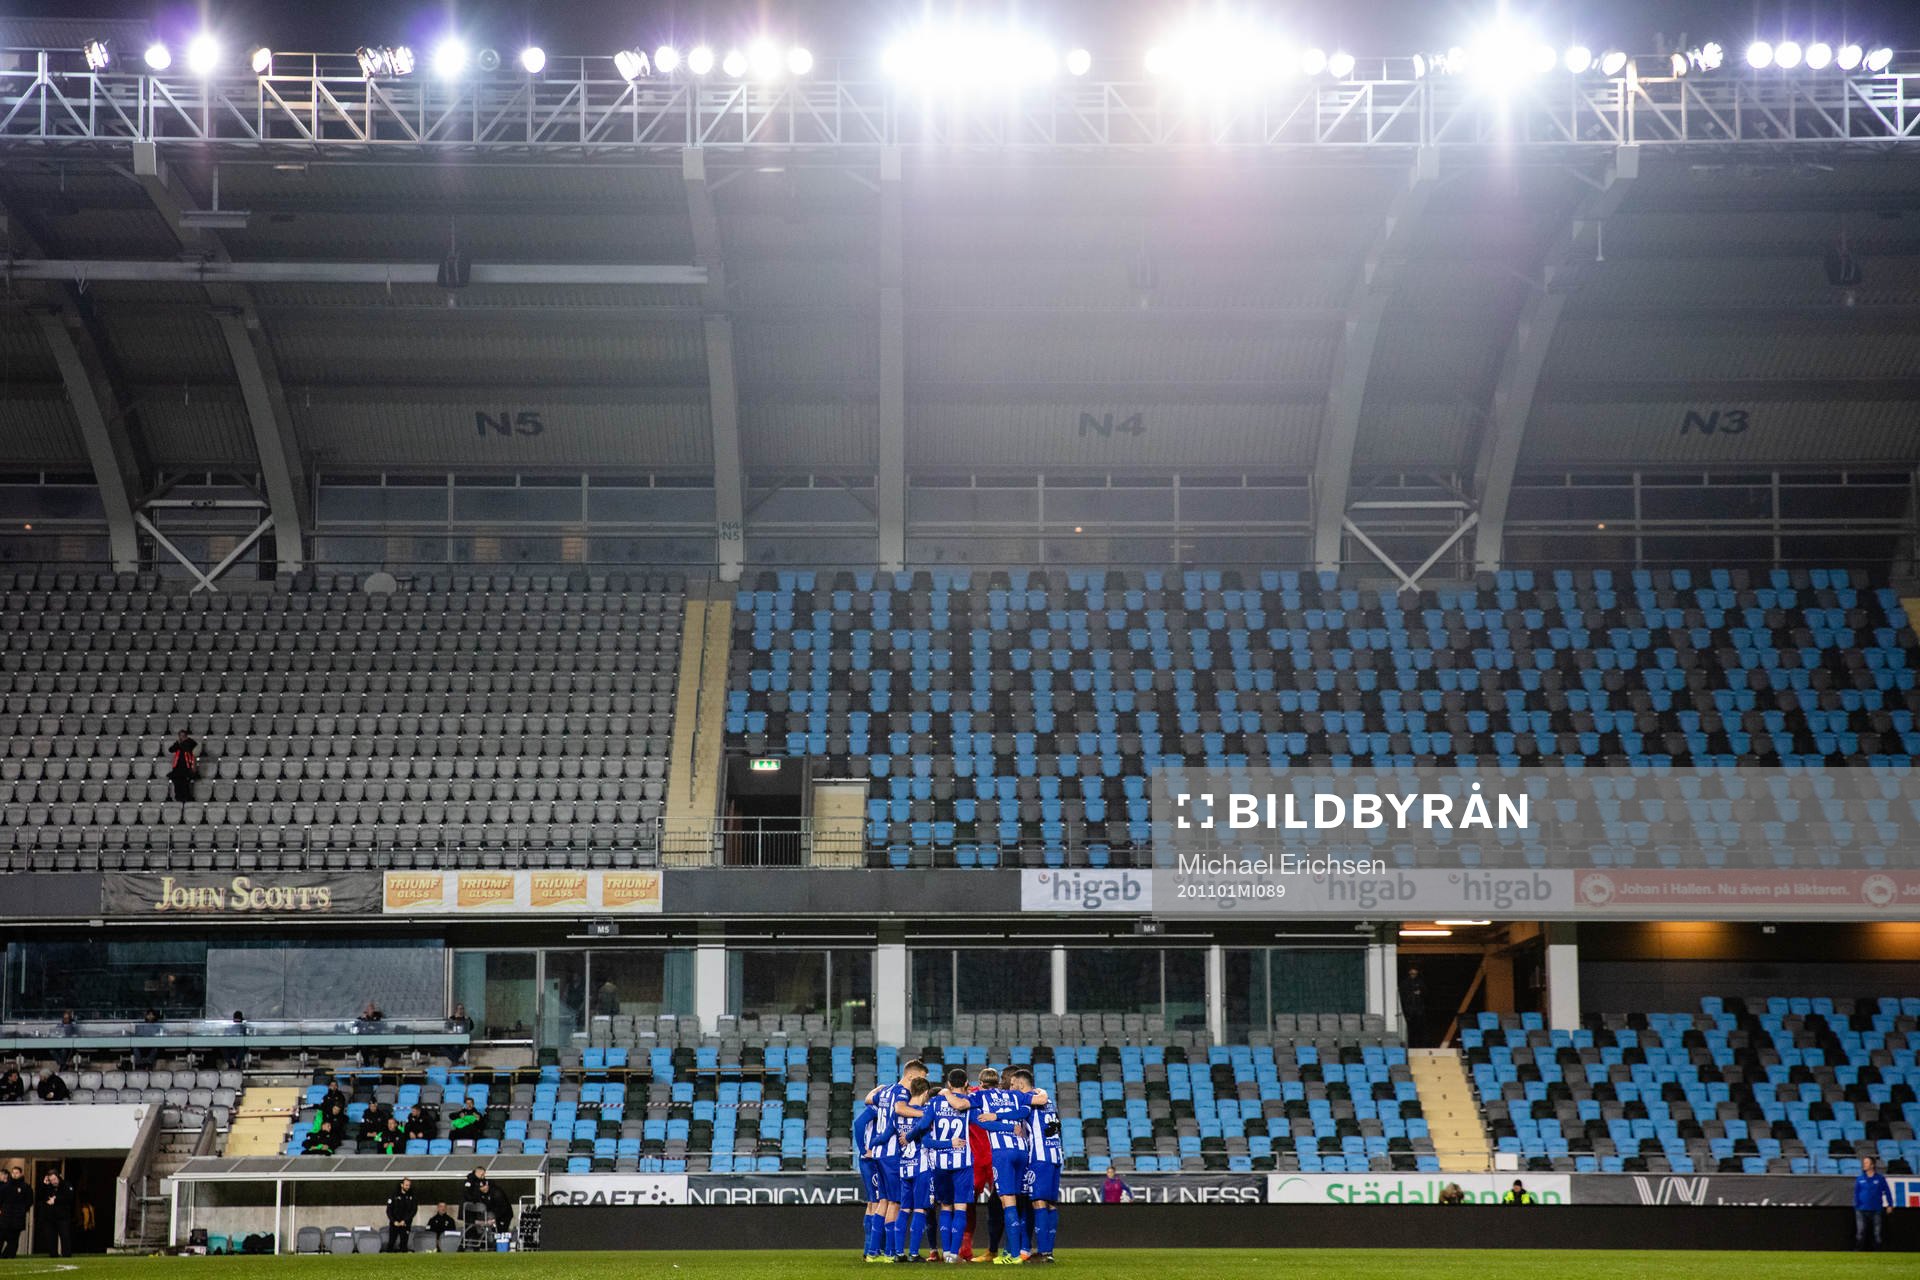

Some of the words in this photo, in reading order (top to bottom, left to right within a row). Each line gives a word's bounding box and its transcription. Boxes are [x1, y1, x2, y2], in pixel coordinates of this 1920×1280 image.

[475, 411, 544, 437] N5
[1079, 412, 1147, 438] N4
[1680, 410, 1749, 434] N3
[390, 878, 440, 889] TRIUMF
[461, 878, 511, 889] TRIUMF
[534, 878, 585, 889] TRIUMF
[606, 878, 656, 889] TRIUMF
[1619, 883, 1659, 895] Johan
[1902, 883, 1920, 896] Jo
[397, 889, 430, 898] GLASS
[468, 889, 502, 898] GLASS
[541, 889, 575, 898] GLASS
[613, 889, 647, 898] GLASS
[1052, 872, 1142, 909] higab
[1328, 872, 1417, 909] higab
[1463, 872, 1552, 909] higab
[938, 1117, 963, 1141] 22
